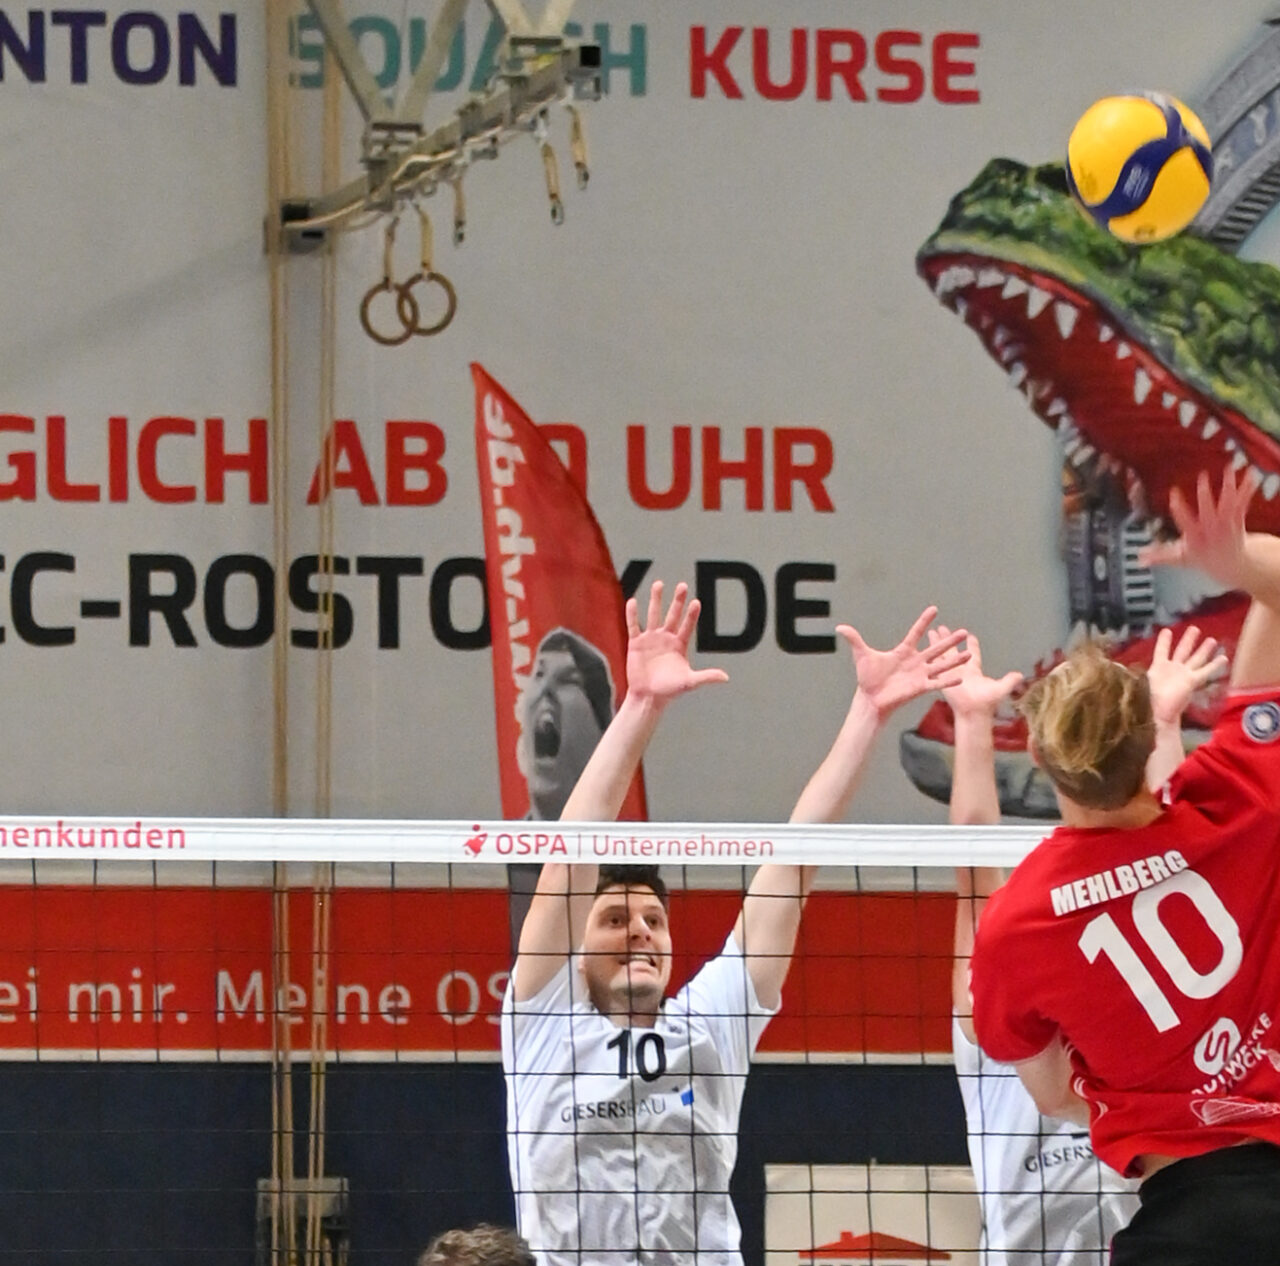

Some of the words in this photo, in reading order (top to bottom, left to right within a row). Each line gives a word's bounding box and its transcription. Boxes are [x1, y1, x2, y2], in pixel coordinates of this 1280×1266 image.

[690, 26, 981, 104] KURSE
[307, 419, 448, 506] AB
[627, 424, 836, 513] UHR
[496, 834, 568, 856] OSPA
[593, 834, 774, 857] Unternehmen
[1050, 850, 1189, 917] MEHLBERG
[1078, 869, 1244, 1033] 10
[68, 967, 188, 1024] mir.
[216, 970, 412, 1024] Meine
[436, 970, 509, 1025] OS
[607, 1029, 667, 1083] 10
